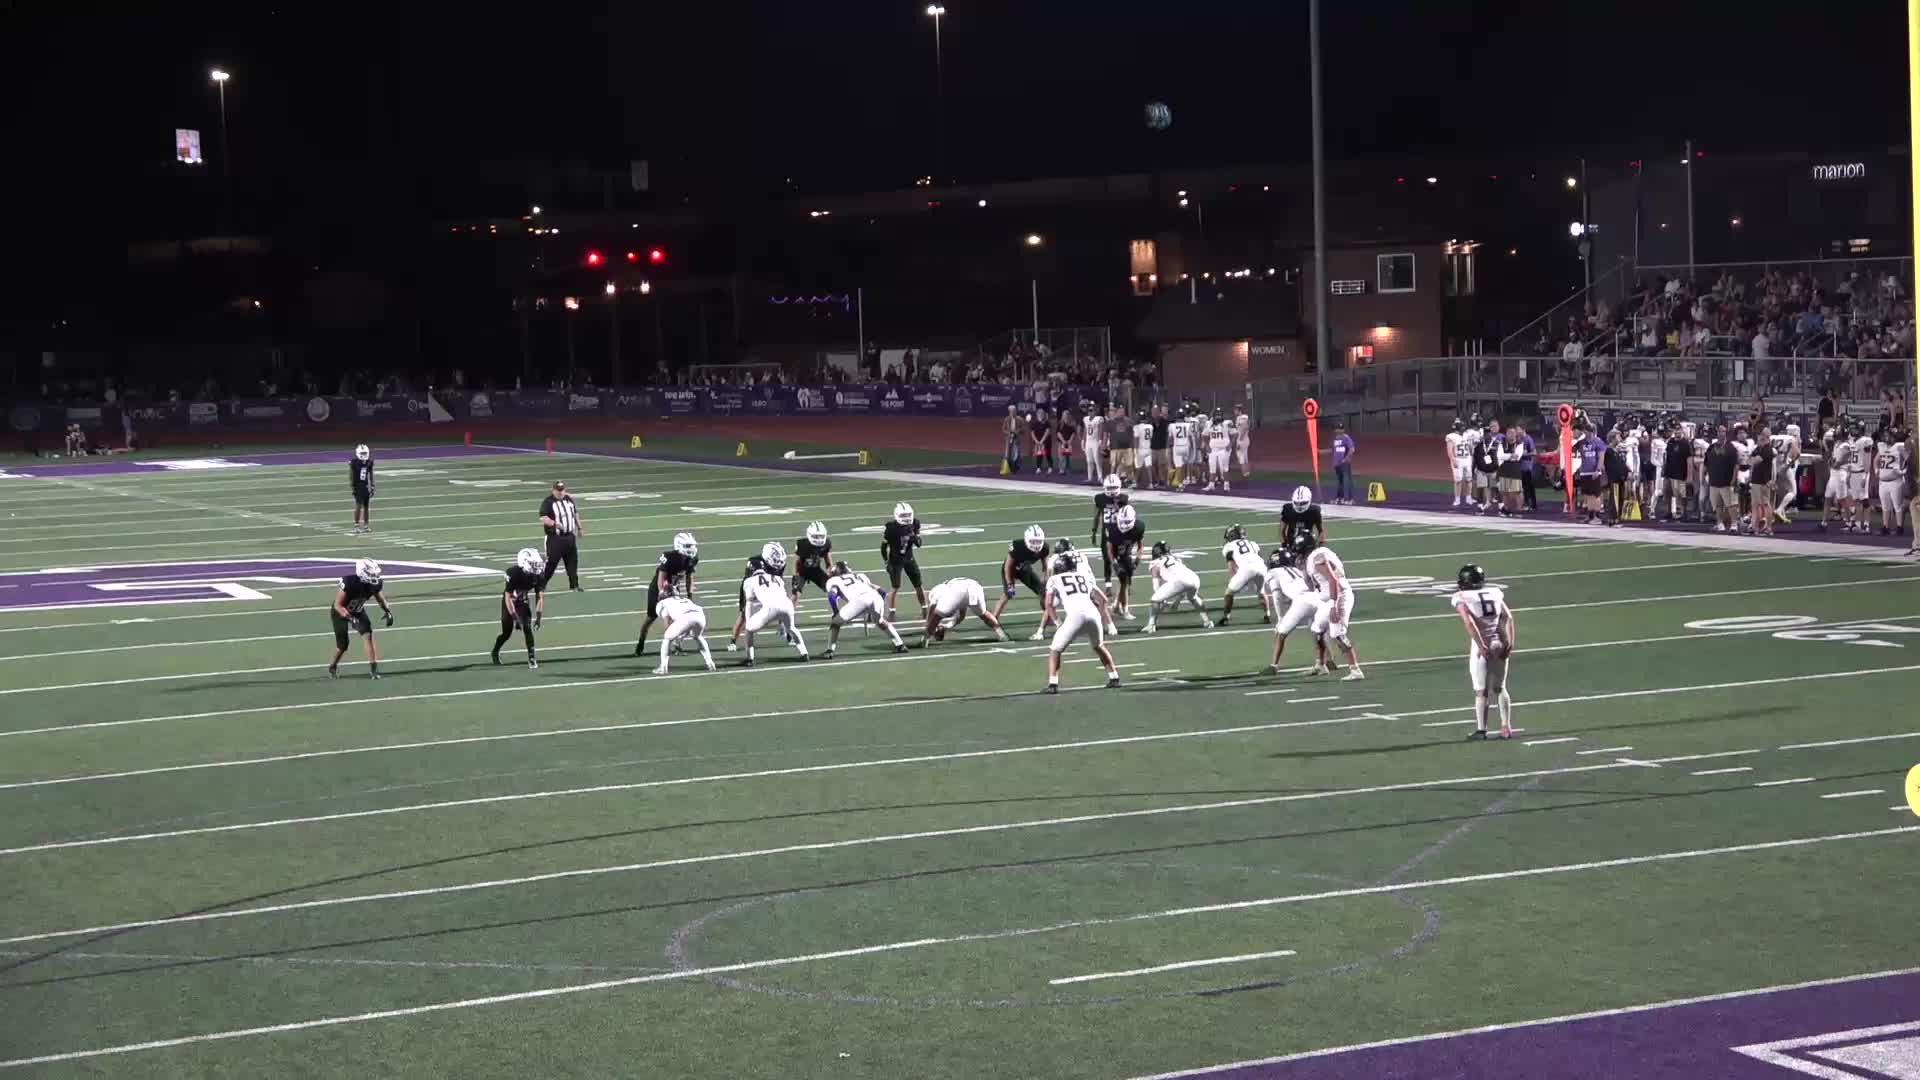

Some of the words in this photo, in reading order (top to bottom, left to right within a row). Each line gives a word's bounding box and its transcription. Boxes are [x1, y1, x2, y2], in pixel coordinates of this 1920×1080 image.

[1813, 163, 1865, 179] marion
[1251, 345, 1285, 355] WOMEN
[890, 400, 904, 408] POINT
[1144, 428, 1151, 440] 8
[1176, 426, 1187, 438] 21
[1236, 540, 1250, 554] 8
[759, 575, 781, 588] 44
[1061, 575, 1088, 595] 58
[1478, 592, 1496, 616] 6
